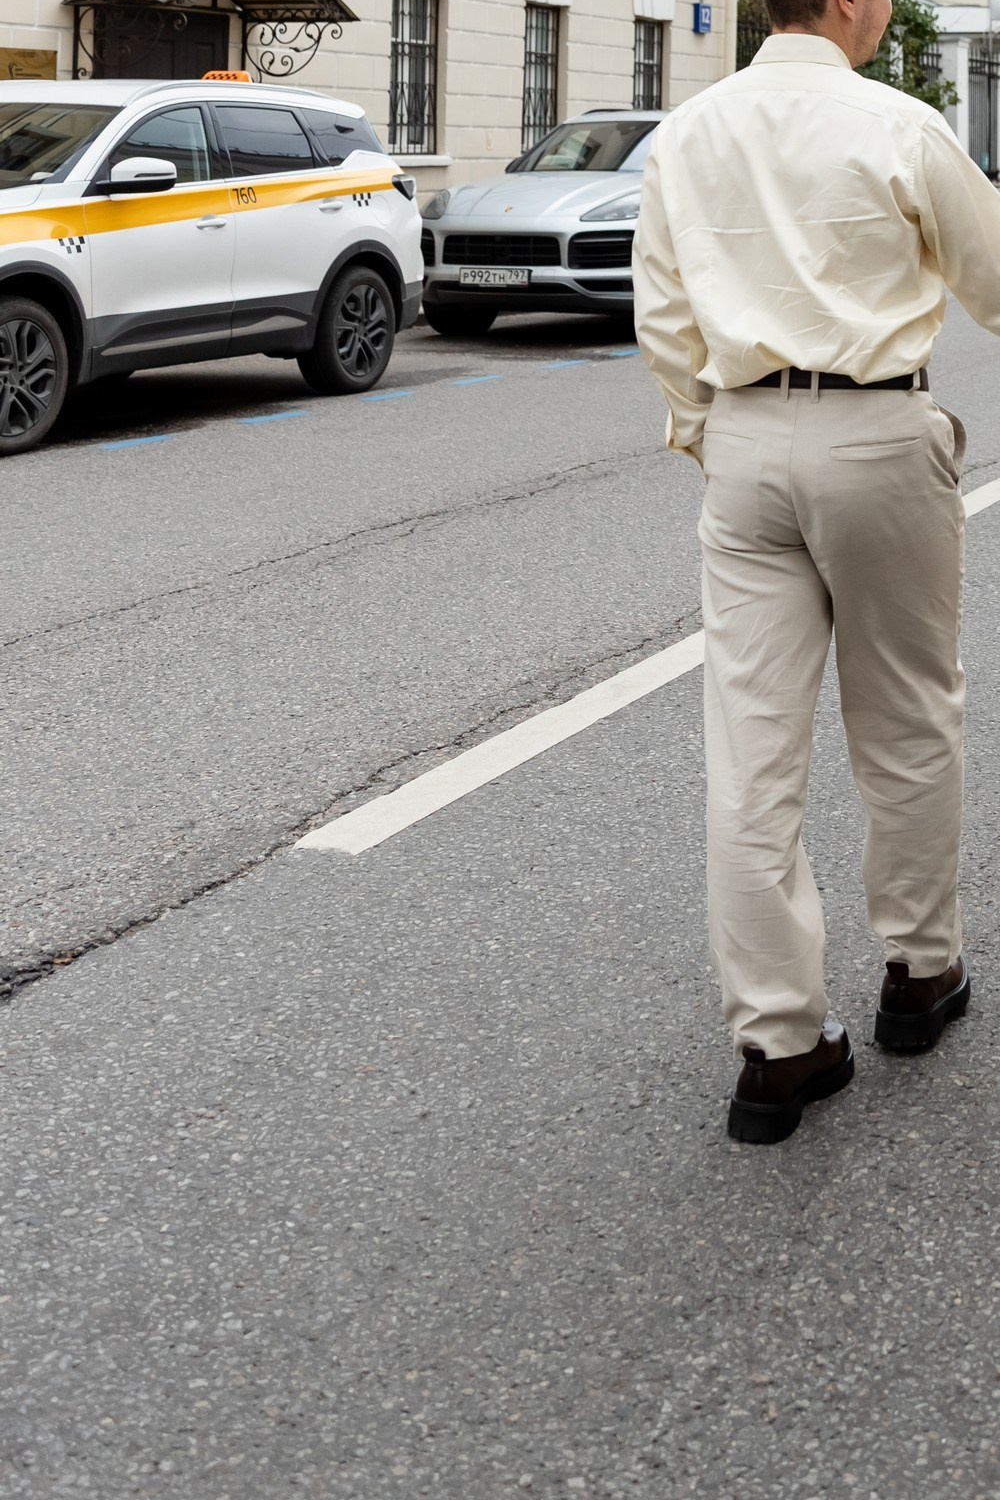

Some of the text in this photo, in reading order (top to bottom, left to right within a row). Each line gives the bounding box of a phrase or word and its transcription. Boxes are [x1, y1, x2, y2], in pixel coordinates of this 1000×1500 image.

[701, 7, 711, 24] 12
[232, 186, 257, 206] 760
[508, 268, 526, 280] 797
